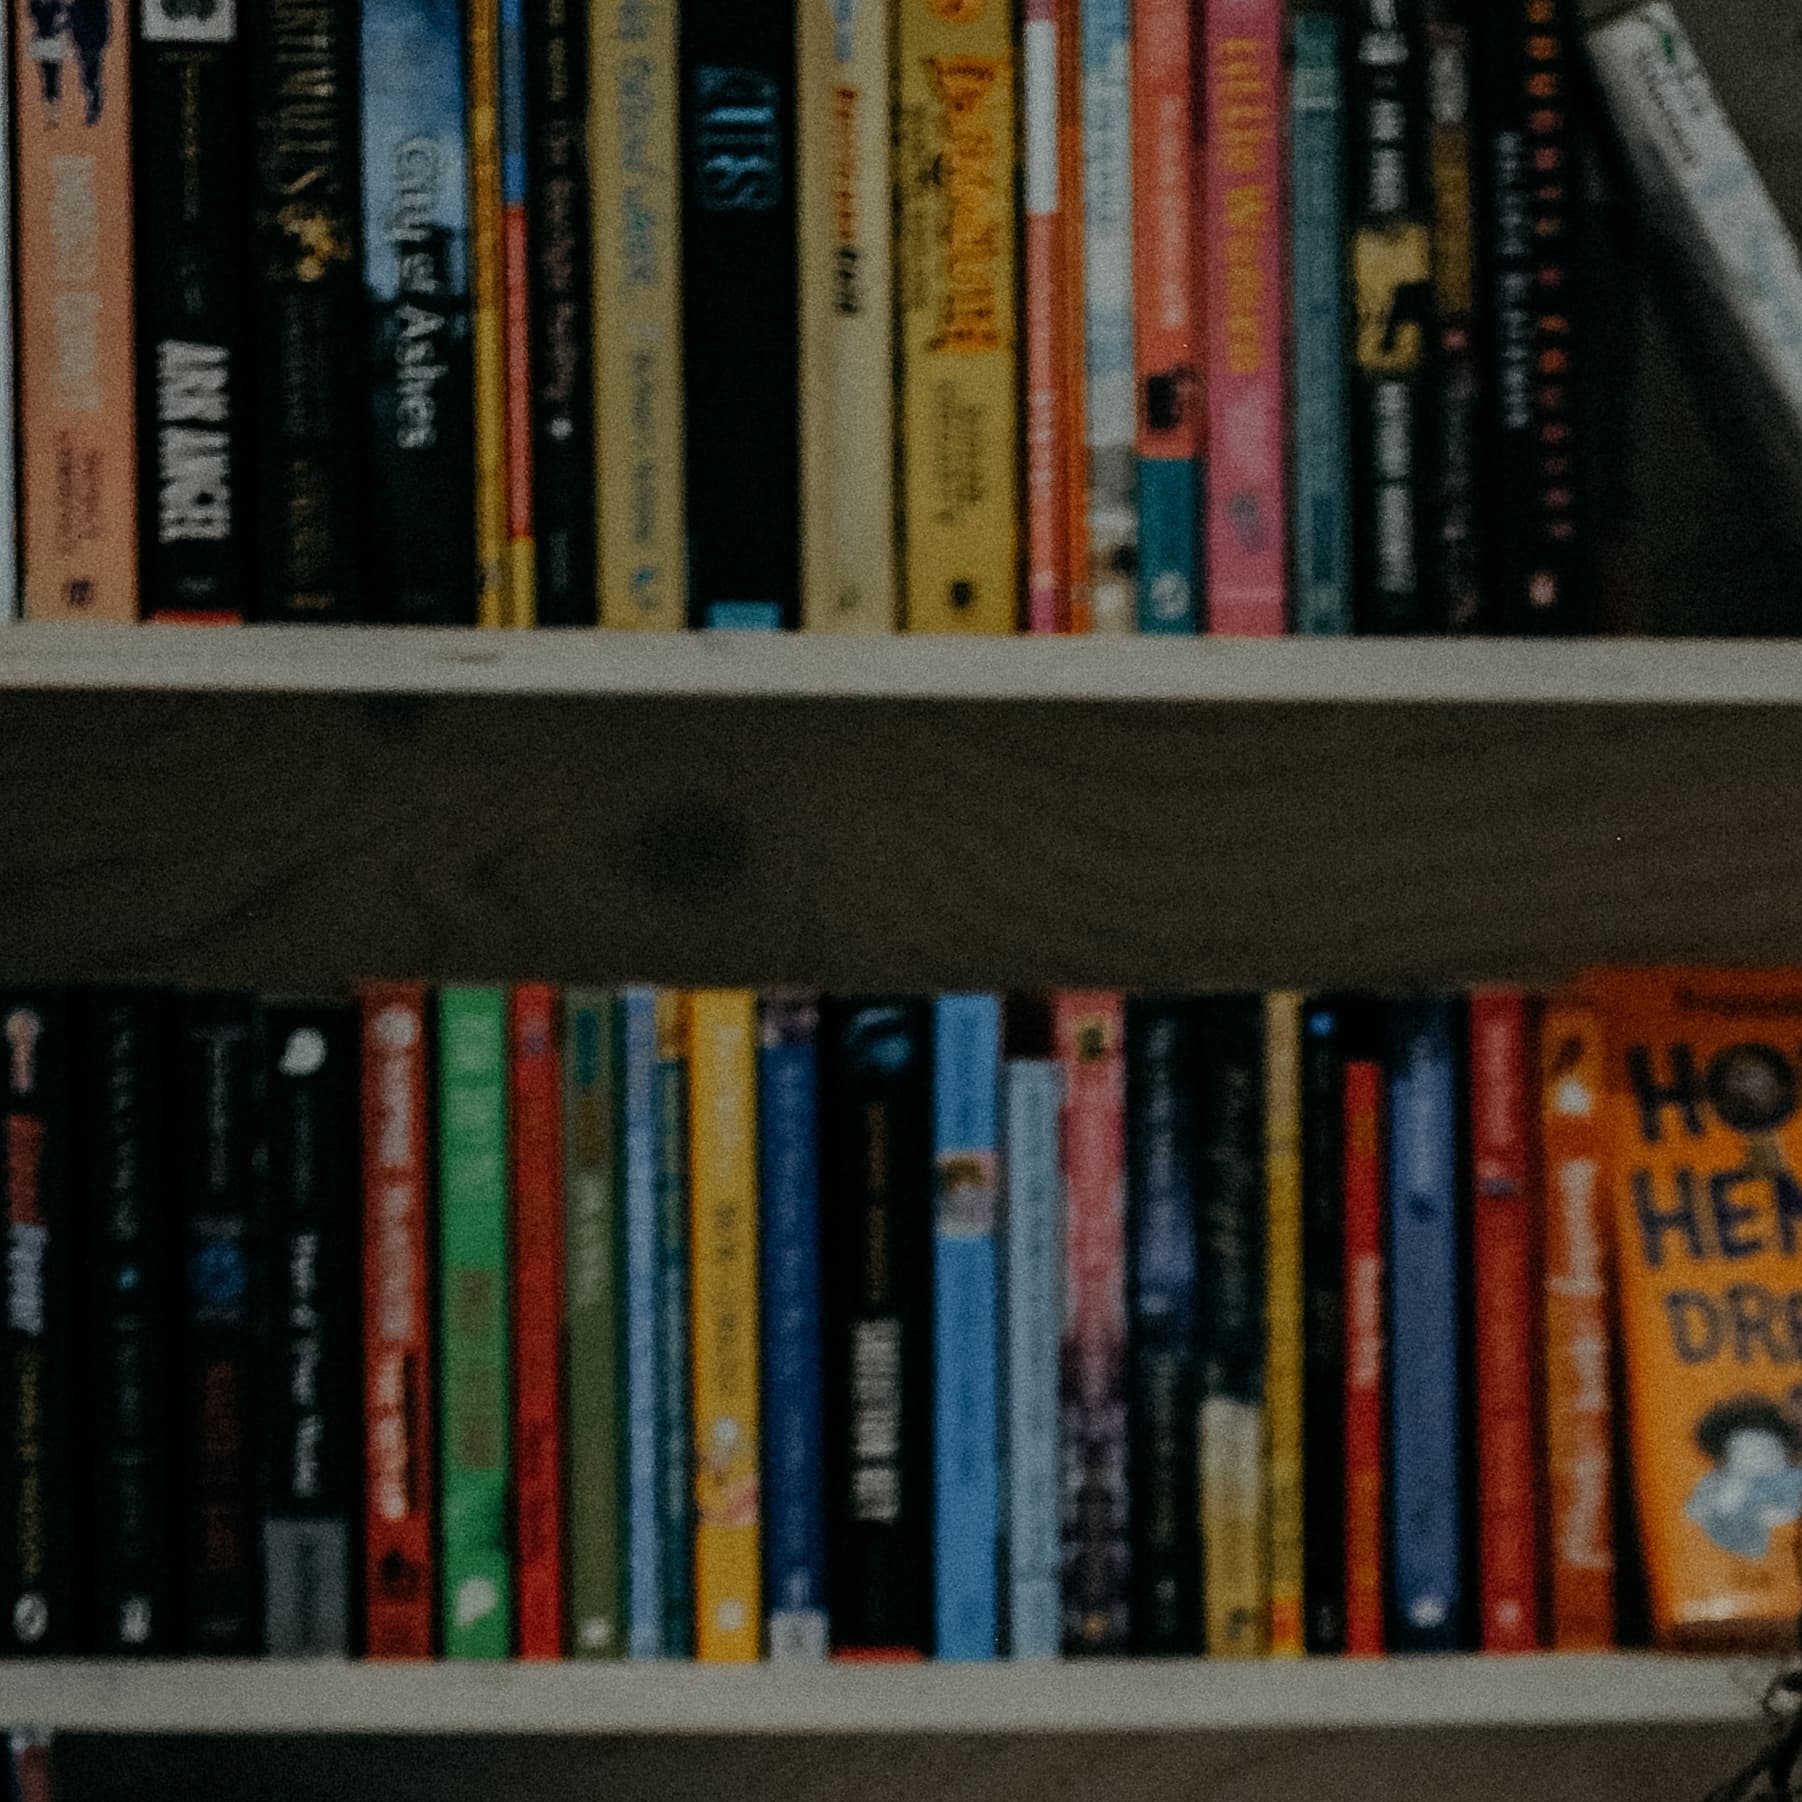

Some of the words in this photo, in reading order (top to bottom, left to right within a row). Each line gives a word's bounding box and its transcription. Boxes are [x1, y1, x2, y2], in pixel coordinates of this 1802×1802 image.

[1214, 34, 1267, 173] Little
[392, 137, 452, 244] City
[1221, 182, 1269, 375] Women
[394, 301, 450, 451] Ashes
